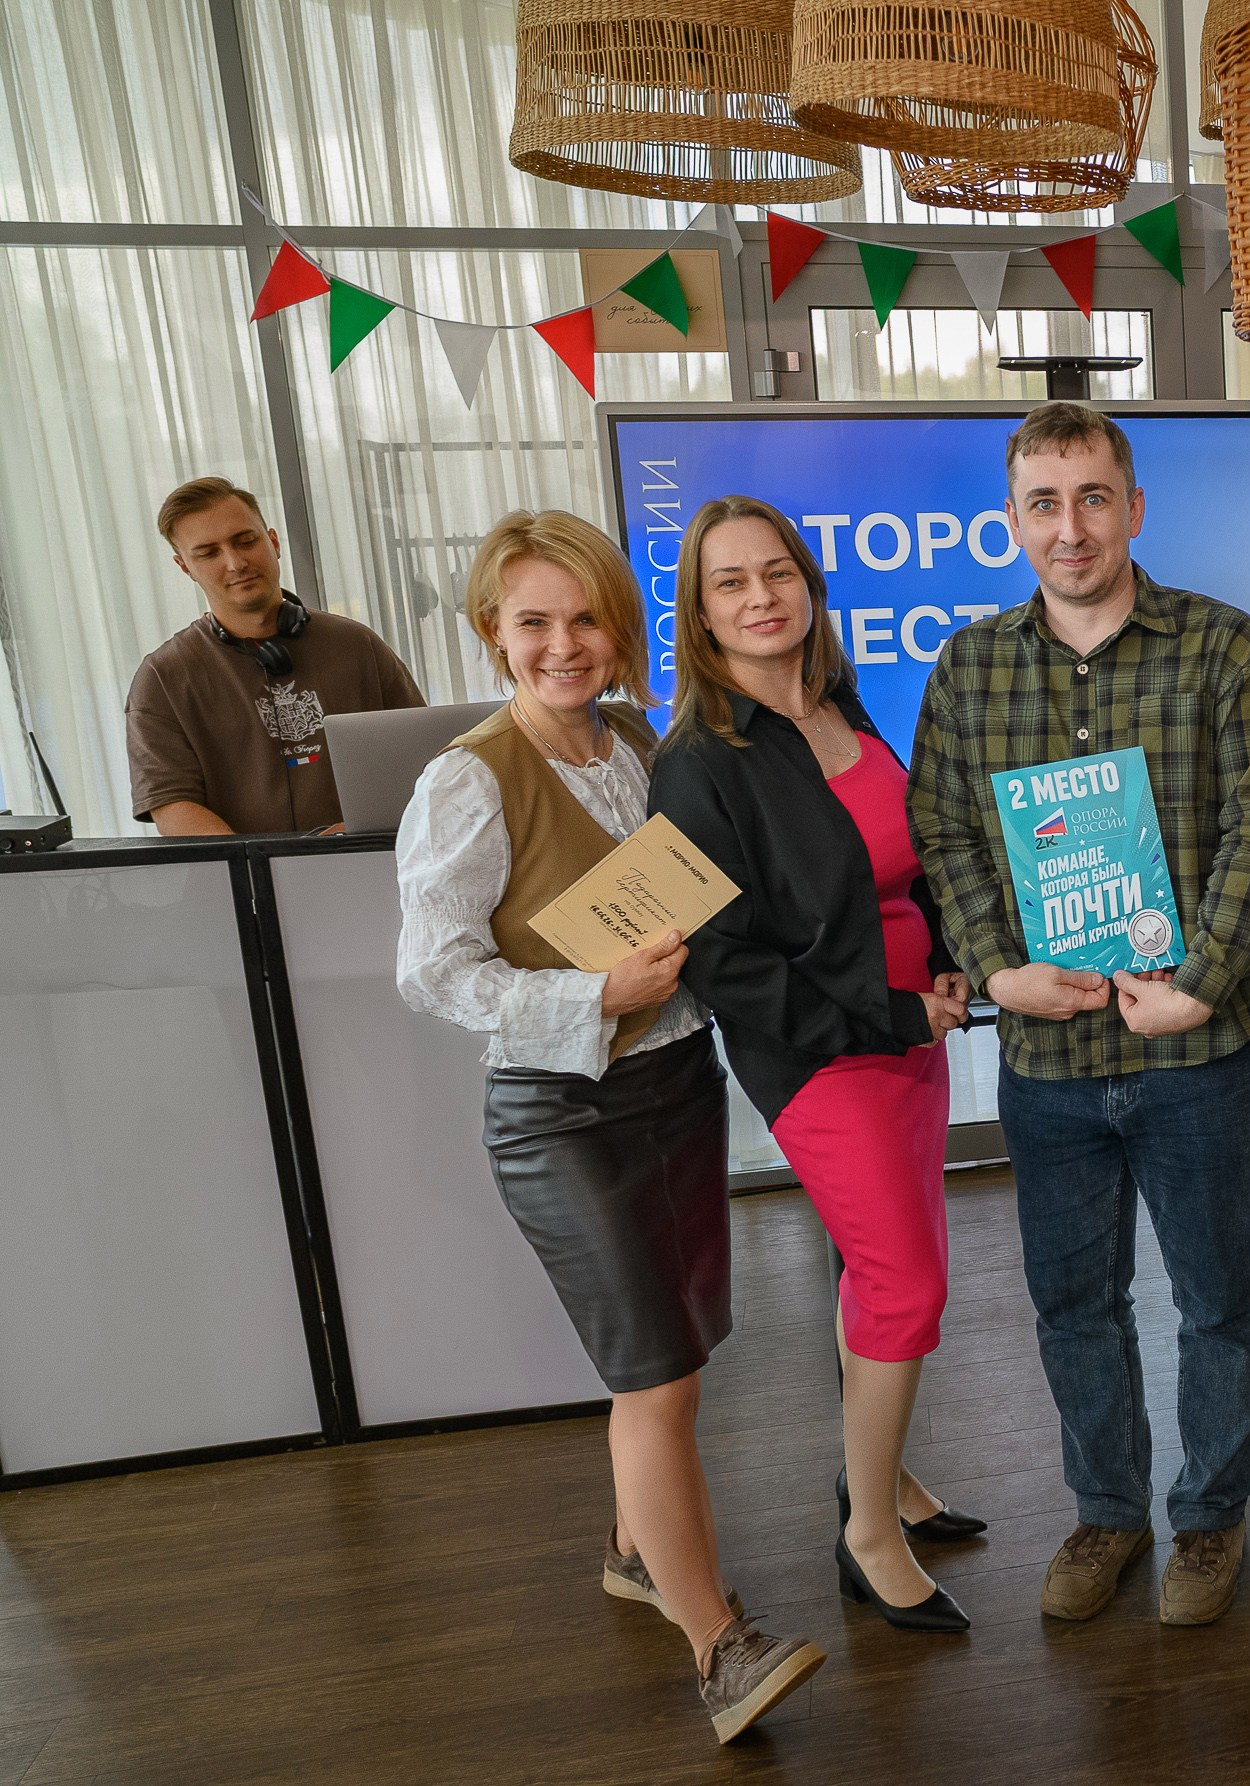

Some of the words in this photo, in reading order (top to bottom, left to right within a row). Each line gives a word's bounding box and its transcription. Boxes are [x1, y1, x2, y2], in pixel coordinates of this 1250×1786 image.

[1007, 778, 1028, 811] 2
[1030, 761, 1120, 806] МЕСТО
[1070, 806, 1118, 824] ОПОРА
[1073, 816, 1128, 836] РОССИИ
[1037, 845, 1109, 881] КОМАНДЕ,
[1040, 871, 1089, 898] КОТОРАЯ
[1091, 861, 1125, 883] БЫЛА
[608, 902, 627, 917] 1500
[1043, 872, 1143, 939] ПОЧТИ
[1049, 929, 1087, 956] САМОЙ
[1088, 916, 1131, 944] КРУТОЙ
